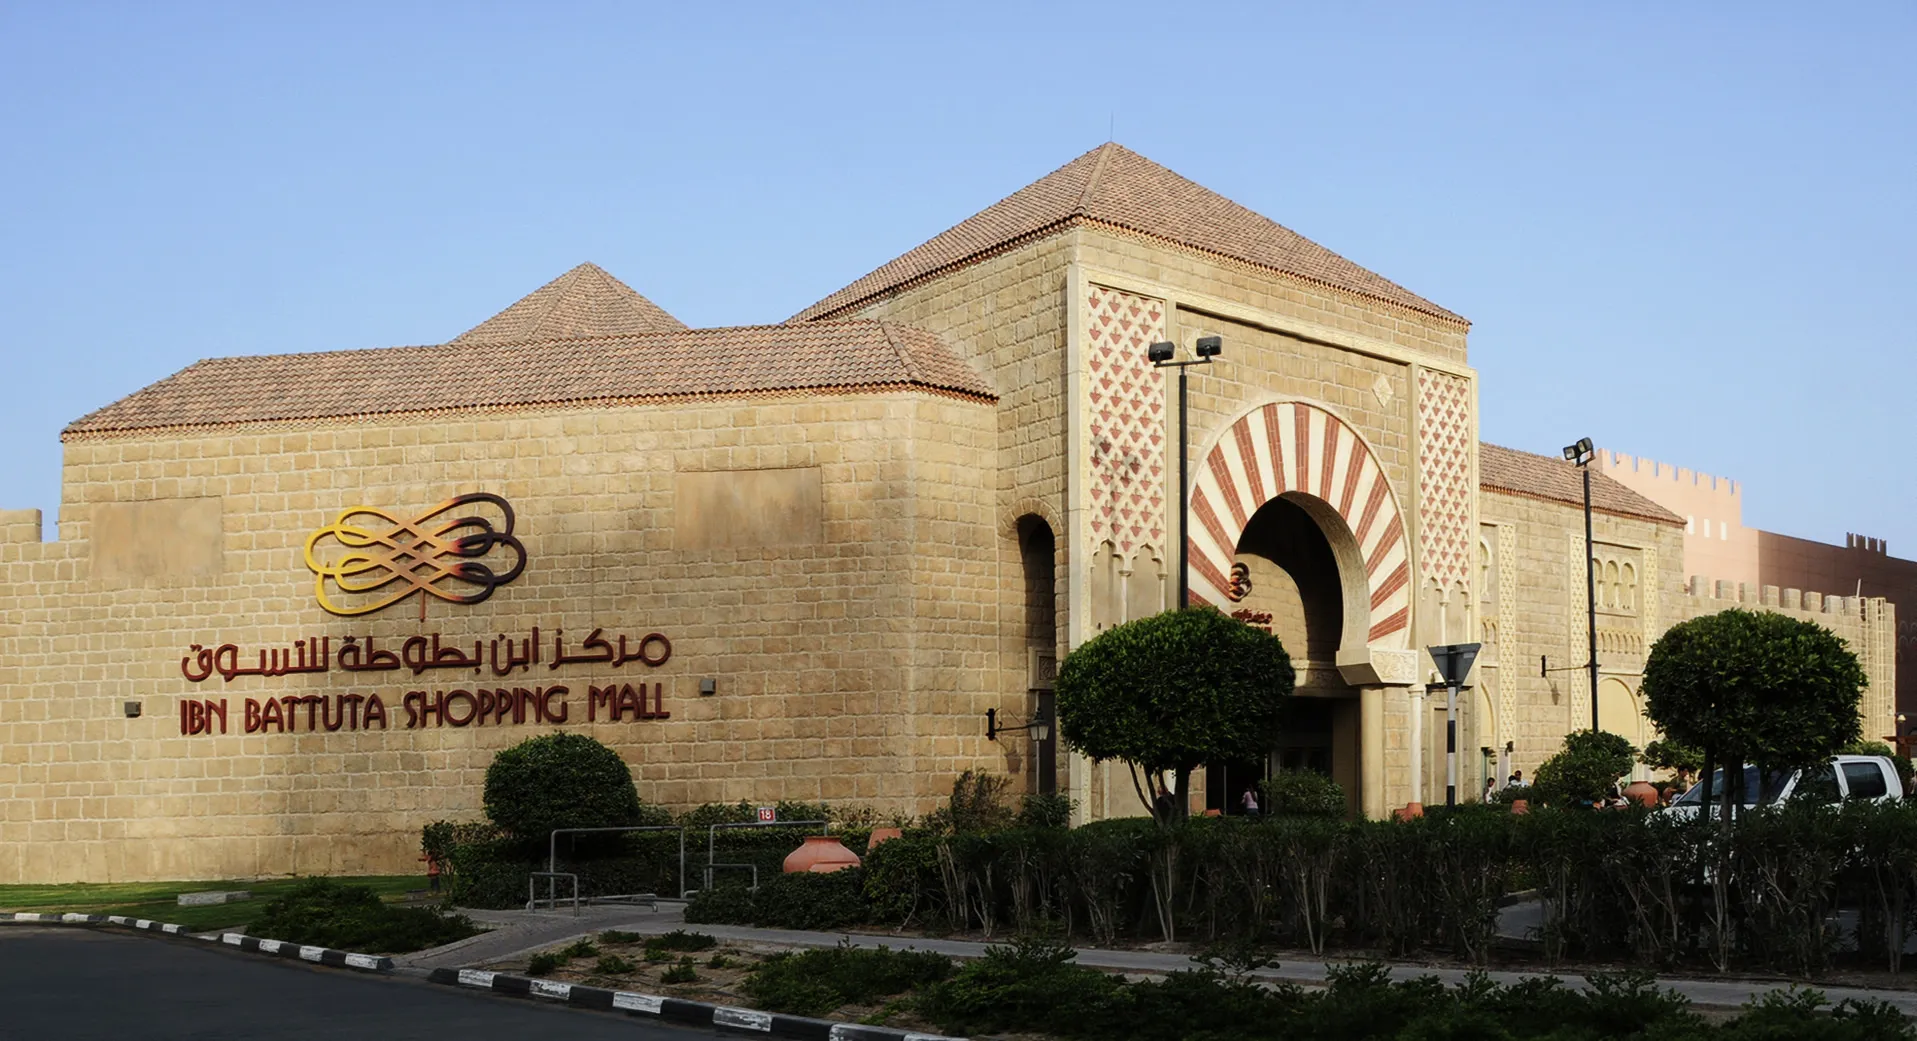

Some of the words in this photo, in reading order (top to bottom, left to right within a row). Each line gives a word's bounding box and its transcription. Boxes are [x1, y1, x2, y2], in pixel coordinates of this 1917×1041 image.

[181, 636, 329, 682] للتسوق
[338, 632, 482, 675] بطوطة
[491, 626, 539, 676] ابن
[549, 628, 671, 670] مركز
[180, 698, 227, 735] IBN
[244, 693, 386, 734] BATTUTA
[403, 685, 569, 729] SHOPPING
[588, 682, 671, 722] MALL
[760, 809, 772, 820] 18
